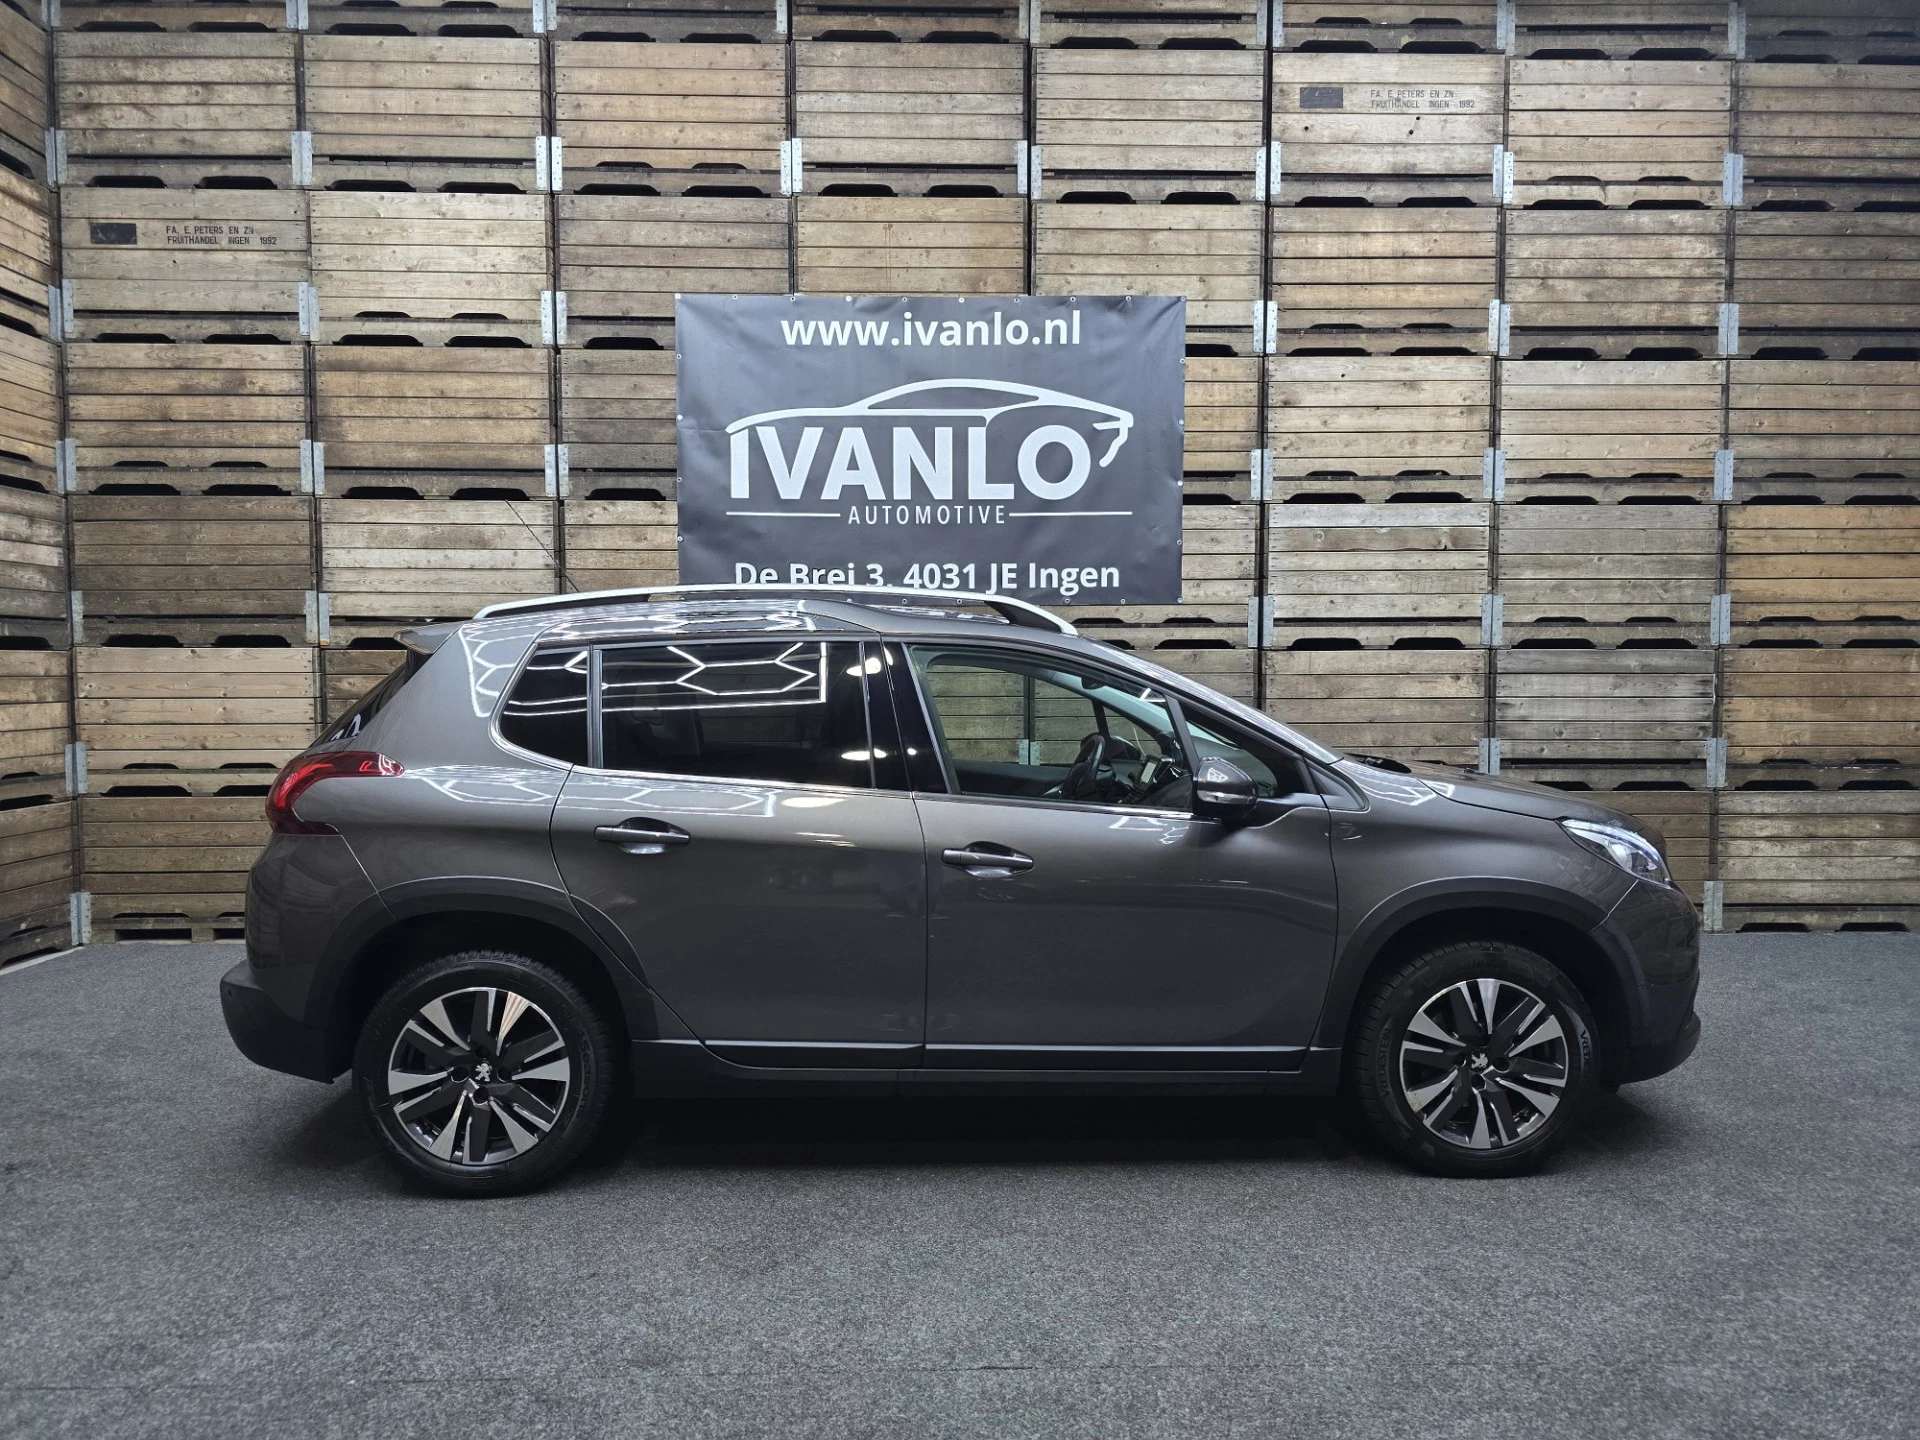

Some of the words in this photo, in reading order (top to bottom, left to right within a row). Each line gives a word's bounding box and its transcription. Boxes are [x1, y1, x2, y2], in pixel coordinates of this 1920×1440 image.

[1397, 89, 1424, 98] PETERS
[1429, 89, 1440, 98] EN
[1458, 99, 1475, 109] 1992
[194, 225, 224, 235] PETERS
[228, 226, 239, 235] EN
[167, 235, 220, 245] FRUITHANDEL
[227, 236, 250, 245] INGEN
[259, 236, 277, 245] 1992
[780, 310, 1081, 346] www.ivanlo.nl
[730, 424, 1092, 500] IVANLO
[848, 505, 1006, 525] AUTOMOTIVE
[735, 562, 779, 585] De
[789, 562, 855, 586] Brei
[903, 563, 976, 589] 4031
[985, 563, 1018, 594] JE
[1029, 562, 1120, 596] Ingen
